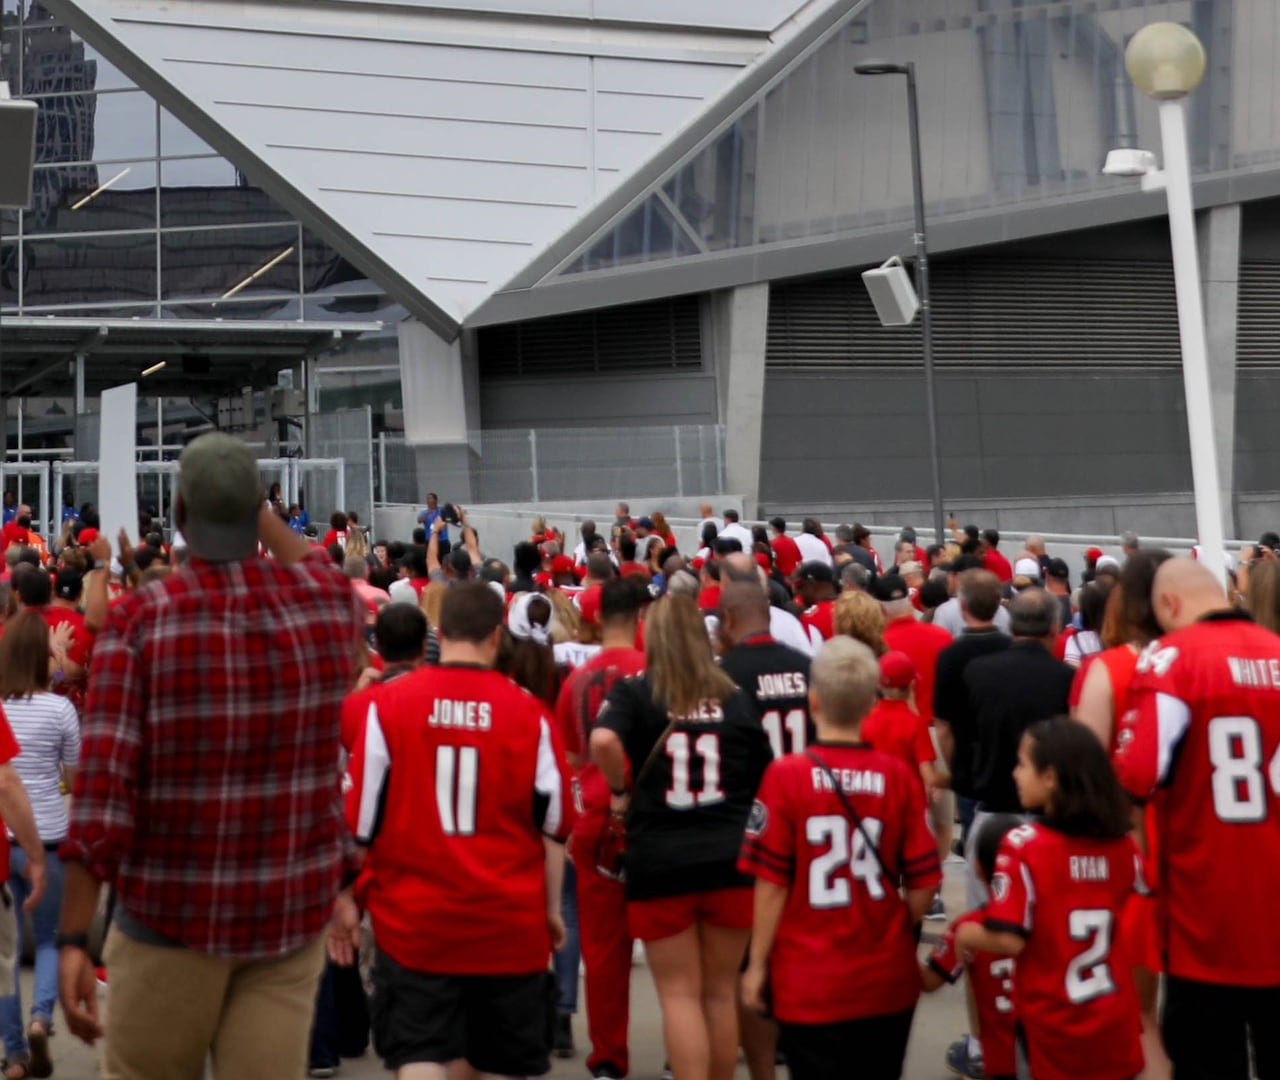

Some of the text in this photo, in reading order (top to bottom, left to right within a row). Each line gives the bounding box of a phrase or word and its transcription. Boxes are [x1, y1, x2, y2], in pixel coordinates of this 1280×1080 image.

[427, 697, 493, 731] JONES
[756, 672, 808, 700] JONES
[761, 708, 807, 760] 11
[434, 743, 479, 836] 11
[665, 731, 726, 810] 11
[805, 814, 886, 908] 24
[1068, 855, 1111, 882] RYAN
[1064, 908, 1117, 1004] 2
